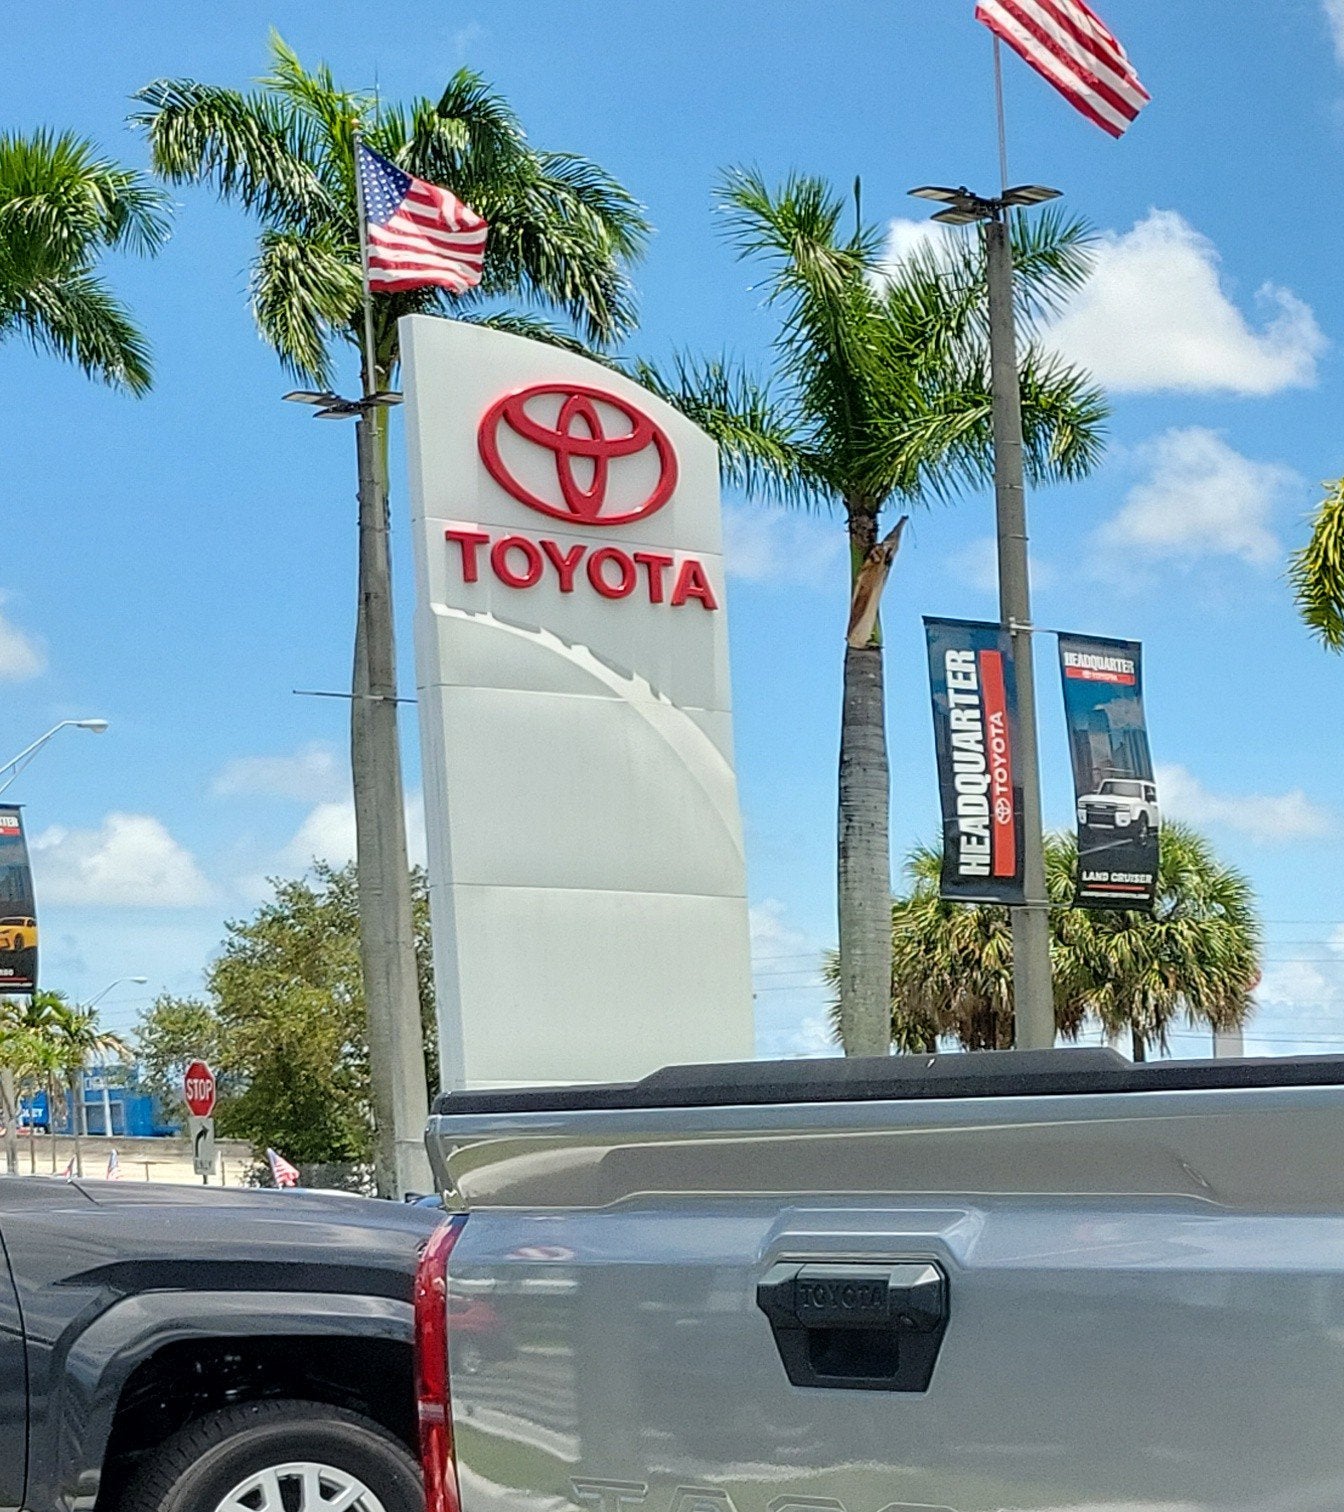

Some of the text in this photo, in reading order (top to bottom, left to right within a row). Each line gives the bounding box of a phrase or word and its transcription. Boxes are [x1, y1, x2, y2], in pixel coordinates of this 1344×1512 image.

[445, 530, 718, 610] TOYOTA
[945, 650, 991, 877] HEADQUARTER
[989, 711, 1008, 793] TOYOTA
[187, 1079, 212, 1100] STOP
[800, 1282, 885, 1309] TOYOTA
